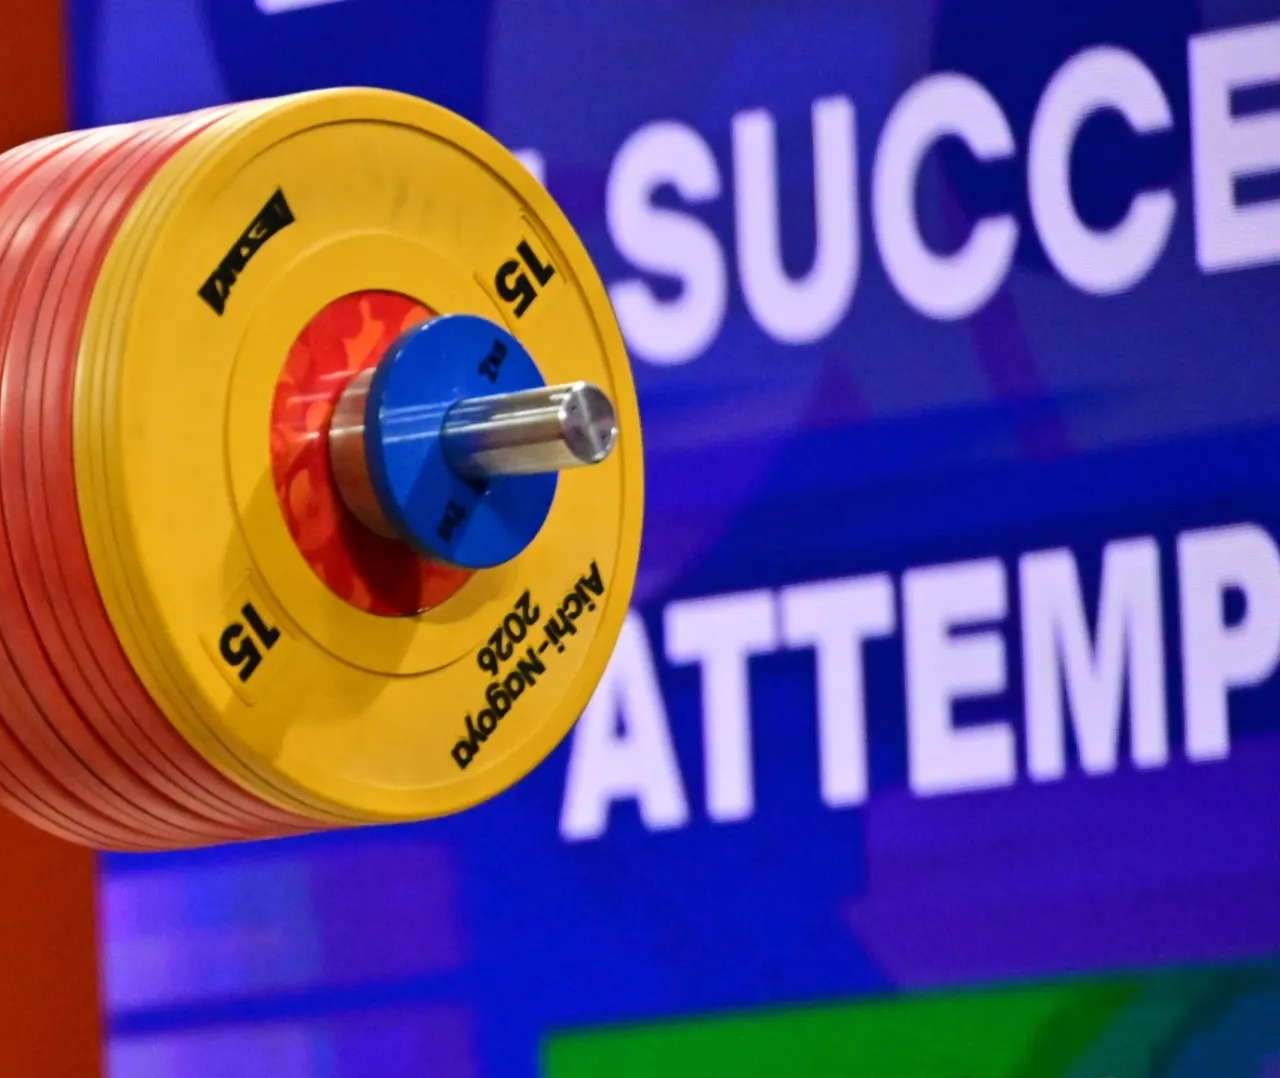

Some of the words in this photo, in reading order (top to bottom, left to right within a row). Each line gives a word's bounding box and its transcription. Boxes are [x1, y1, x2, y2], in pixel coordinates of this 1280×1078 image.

[606, 20, 1280, 365] SUCCE
[495, 238, 556, 319] 15
[219, 602, 281, 683] 15
[450, 560, 604, 770] Aichi-Nagoya
[477, 588, 540, 676] 2026
[559, 522, 1280, 842] ATTEMP
